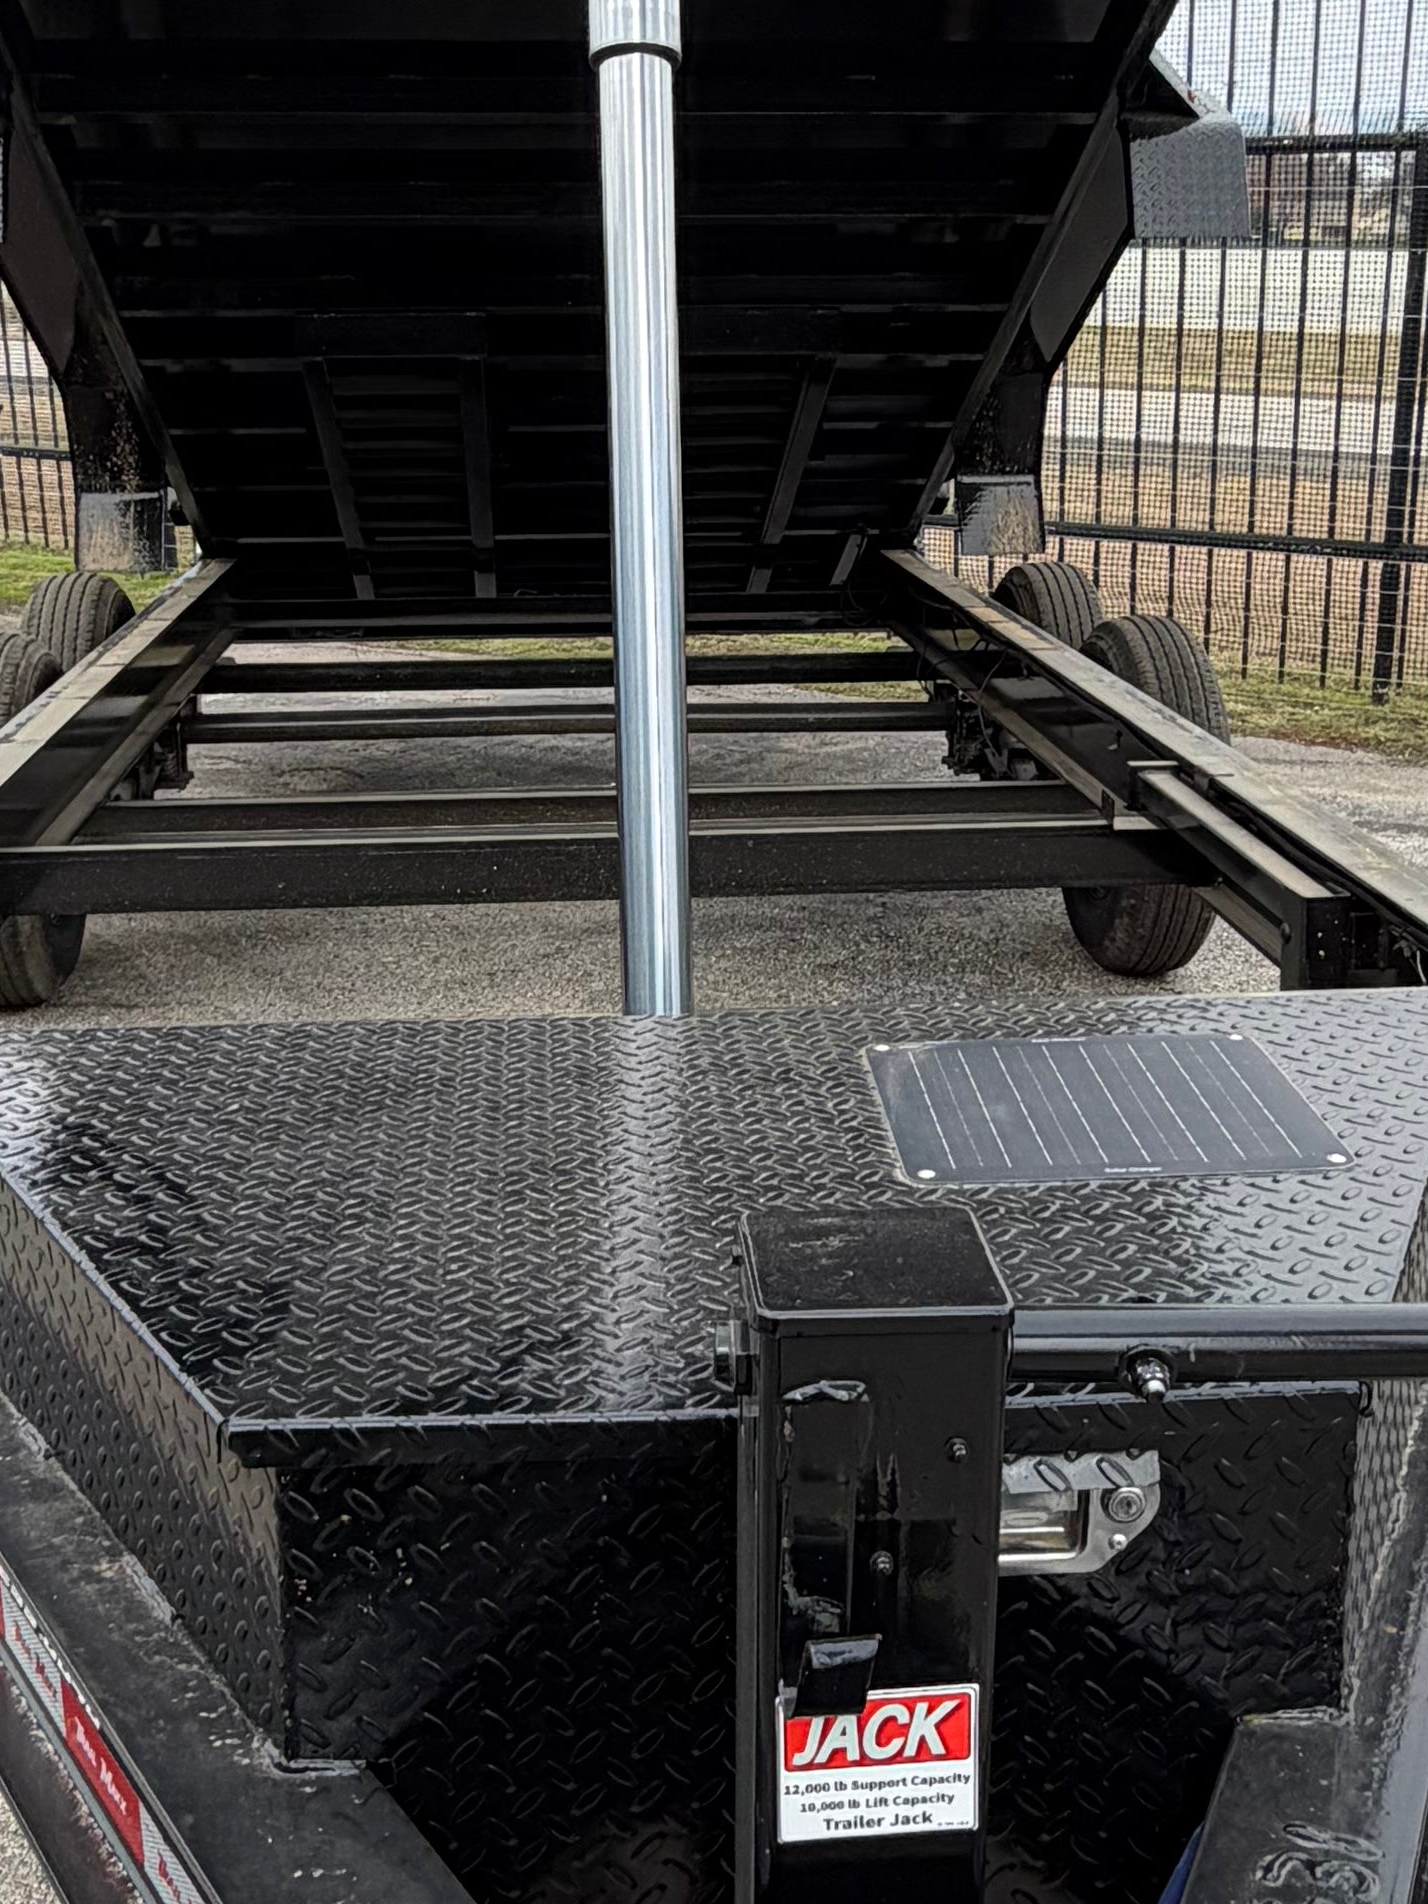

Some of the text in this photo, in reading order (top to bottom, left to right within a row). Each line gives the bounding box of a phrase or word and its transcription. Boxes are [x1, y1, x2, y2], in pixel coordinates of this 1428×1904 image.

[791, 1699, 963, 1767] JACK
[784, 1773, 971, 1797] 12,000 lb Support Capacity
[800, 1792, 955, 1815] 10,000 lb Lift Capacity
[823, 1815, 886, 1832] Trailer
[890, 1811, 933, 1827] Jack
